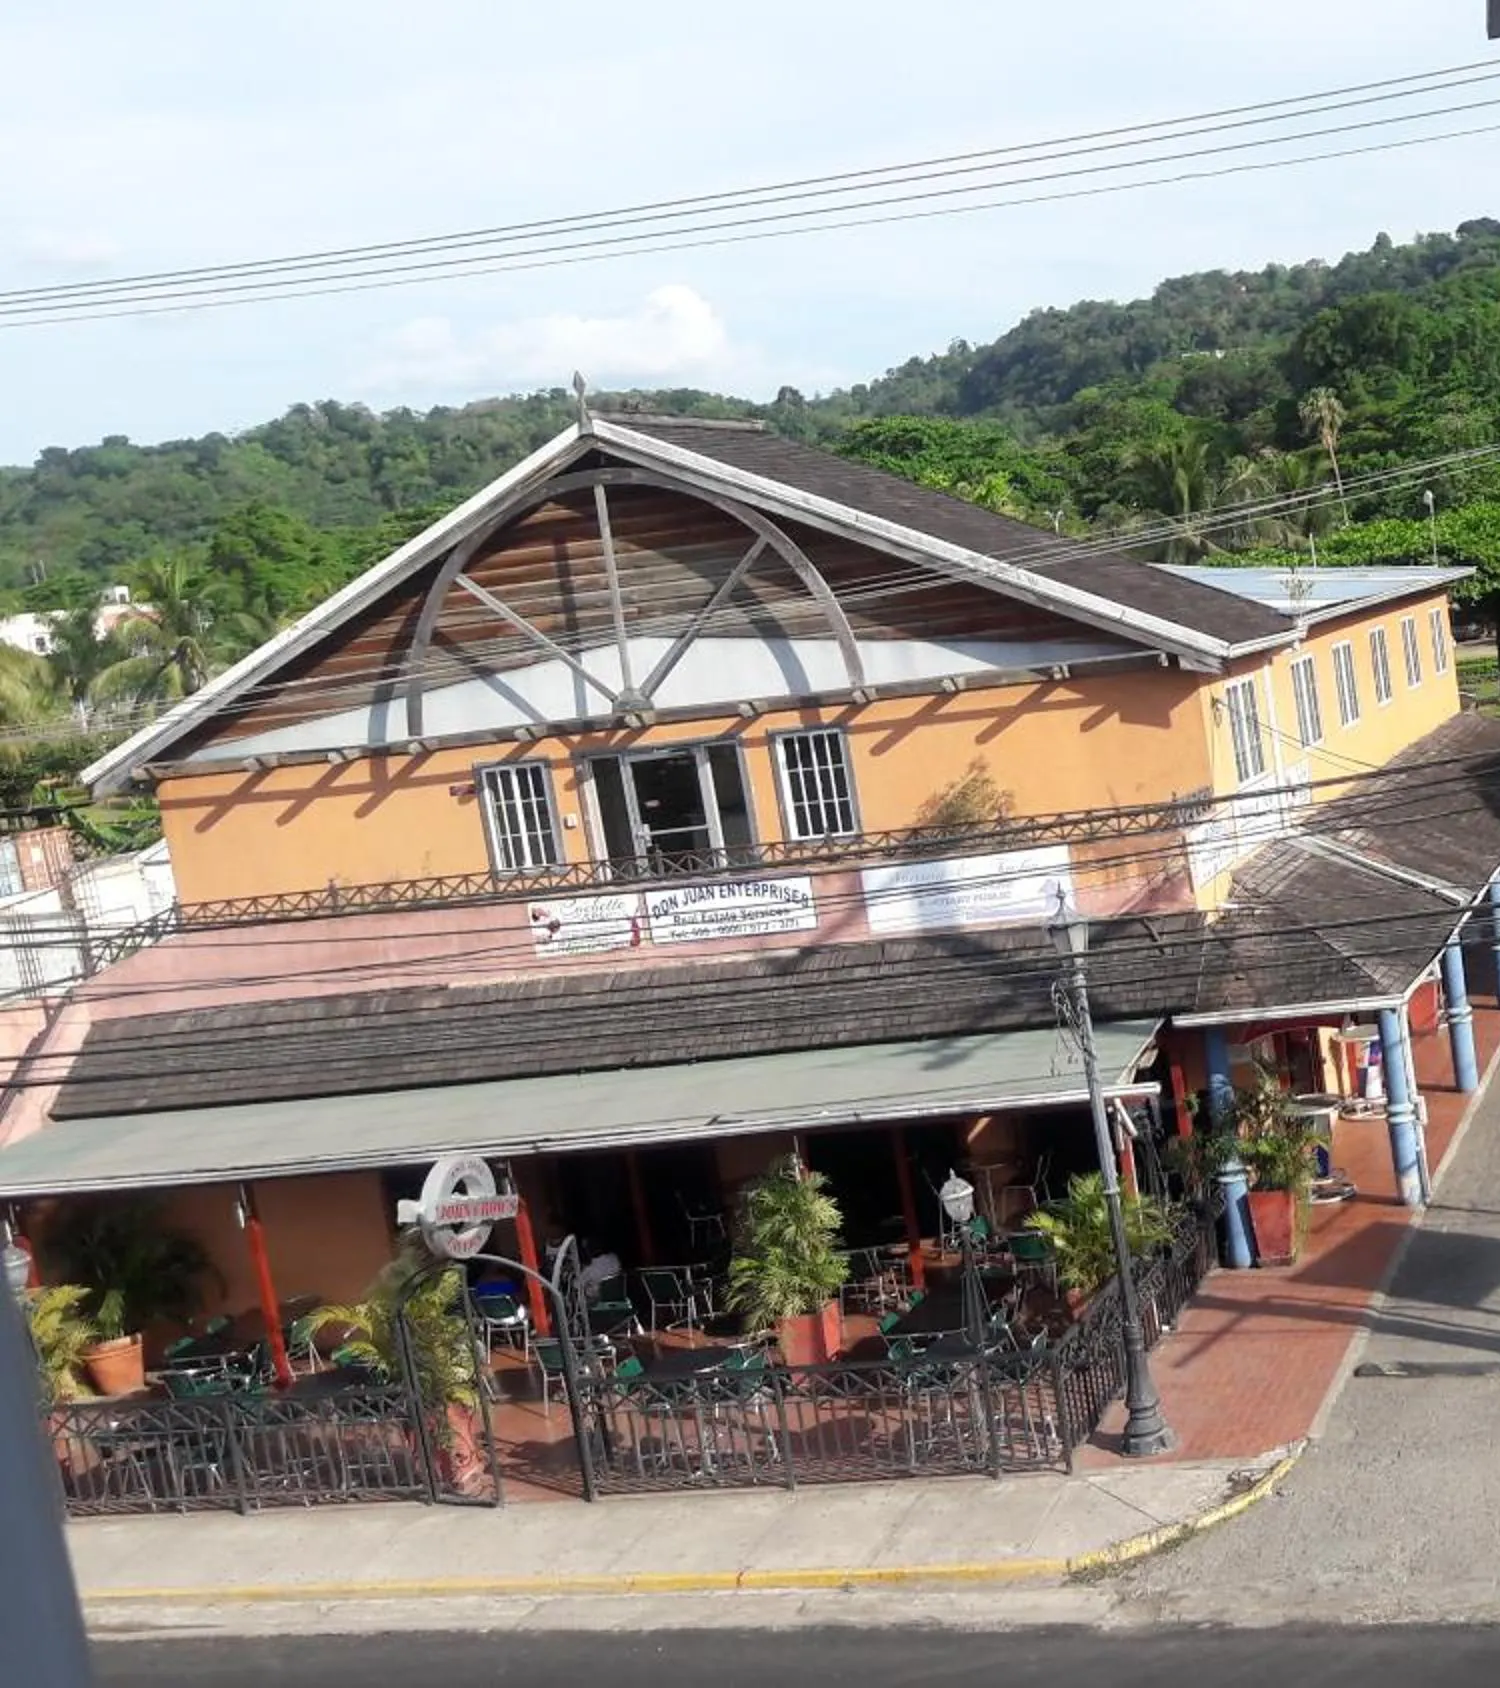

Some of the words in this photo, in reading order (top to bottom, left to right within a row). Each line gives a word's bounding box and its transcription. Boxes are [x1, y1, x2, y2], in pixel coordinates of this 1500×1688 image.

[652, 894, 679, 920] DON
[683, 884, 715, 907] JUAN
[719, 881, 809, 908] ENTERPRISES
